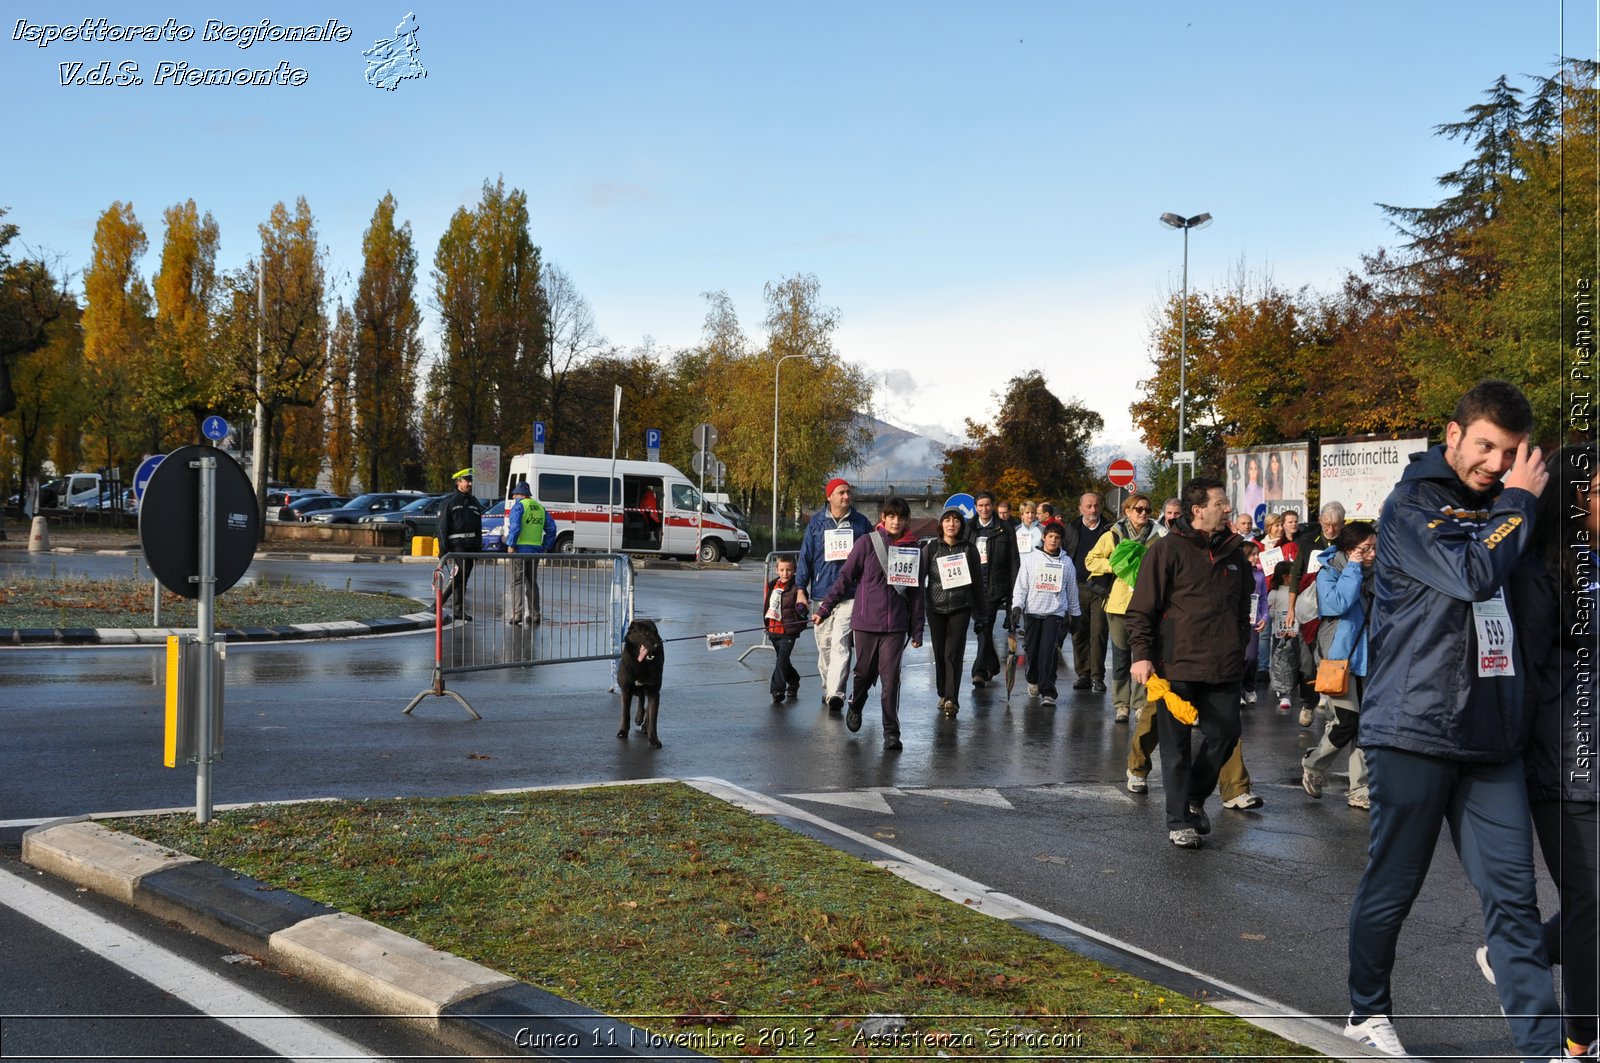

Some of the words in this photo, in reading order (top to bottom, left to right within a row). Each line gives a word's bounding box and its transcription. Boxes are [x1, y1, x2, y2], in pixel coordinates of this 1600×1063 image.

[535, 423, 543, 441] P
[649, 431, 658, 447] P
[1323, 446, 1399, 467] scrittorincittà
[1323, 468, 1339, 477] 2012
[830, 540, 848, 550] 1366
[894, 562, 913, 574] 1365
[947, 566, 962, 578] 248
[1040, 573, 1057, 582] 1364
[1485, 619, 1505, 646] 699
